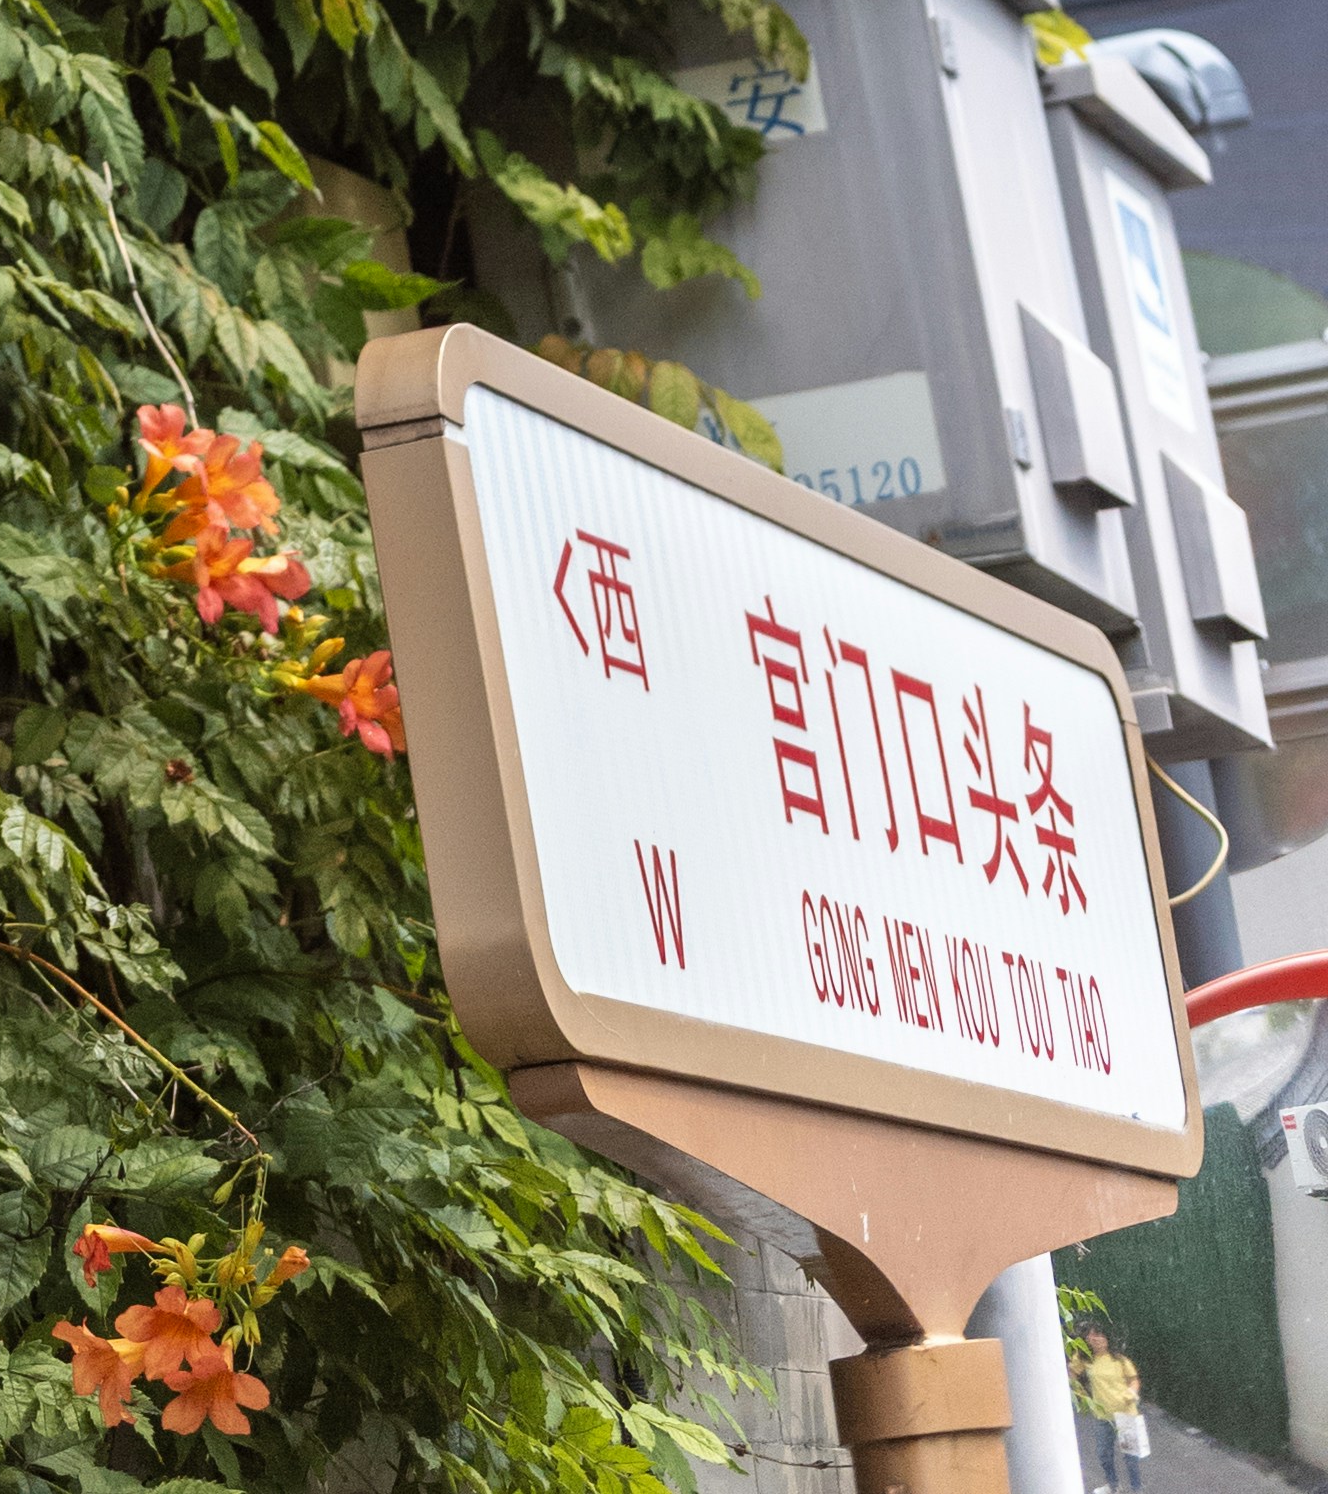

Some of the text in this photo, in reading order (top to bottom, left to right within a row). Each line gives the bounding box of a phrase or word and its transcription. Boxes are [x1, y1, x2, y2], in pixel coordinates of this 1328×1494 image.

[575, 527, 1087, 916] 西 宫门口头条
[633, 838, 1111, 1076] W GONG MEN KOU TOU TIAO
